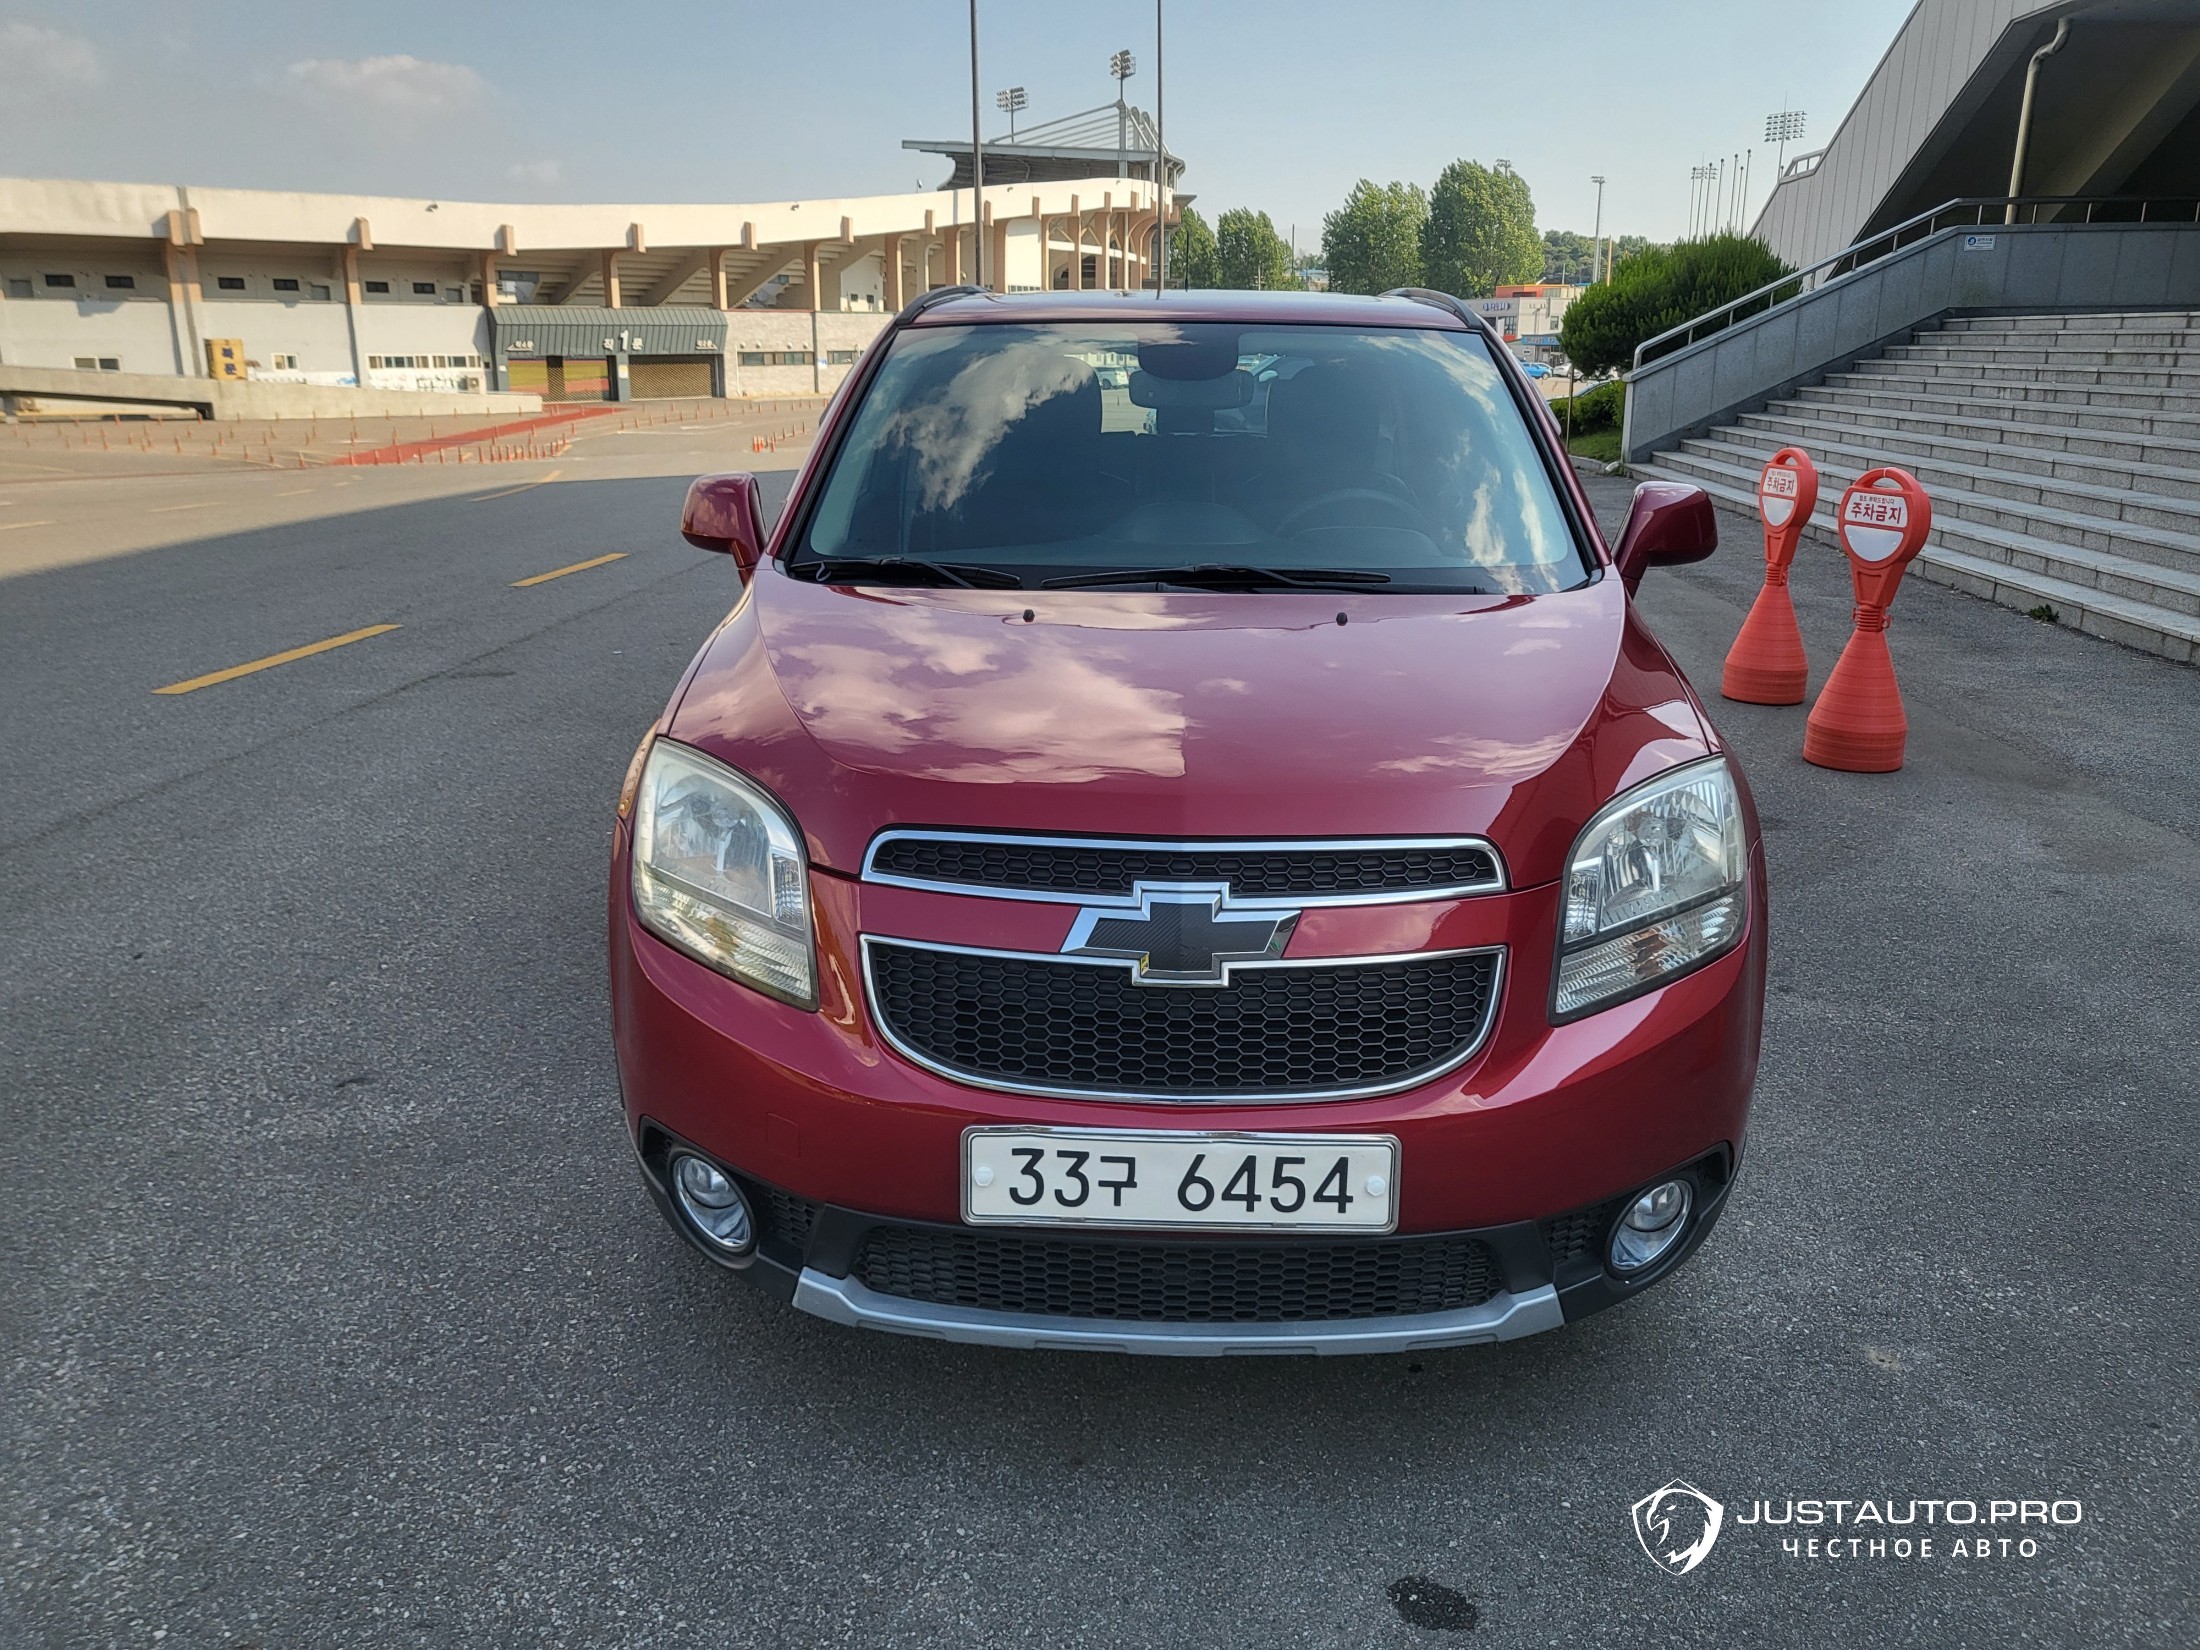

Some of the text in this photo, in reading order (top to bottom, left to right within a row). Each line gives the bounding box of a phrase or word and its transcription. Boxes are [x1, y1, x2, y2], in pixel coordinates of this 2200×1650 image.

[1766, 476, 1795, 494] 주차금지
[1851, 502, 1902, 524] 주차금지
[1008, 1147, 1354, 1213] 33구 6454
